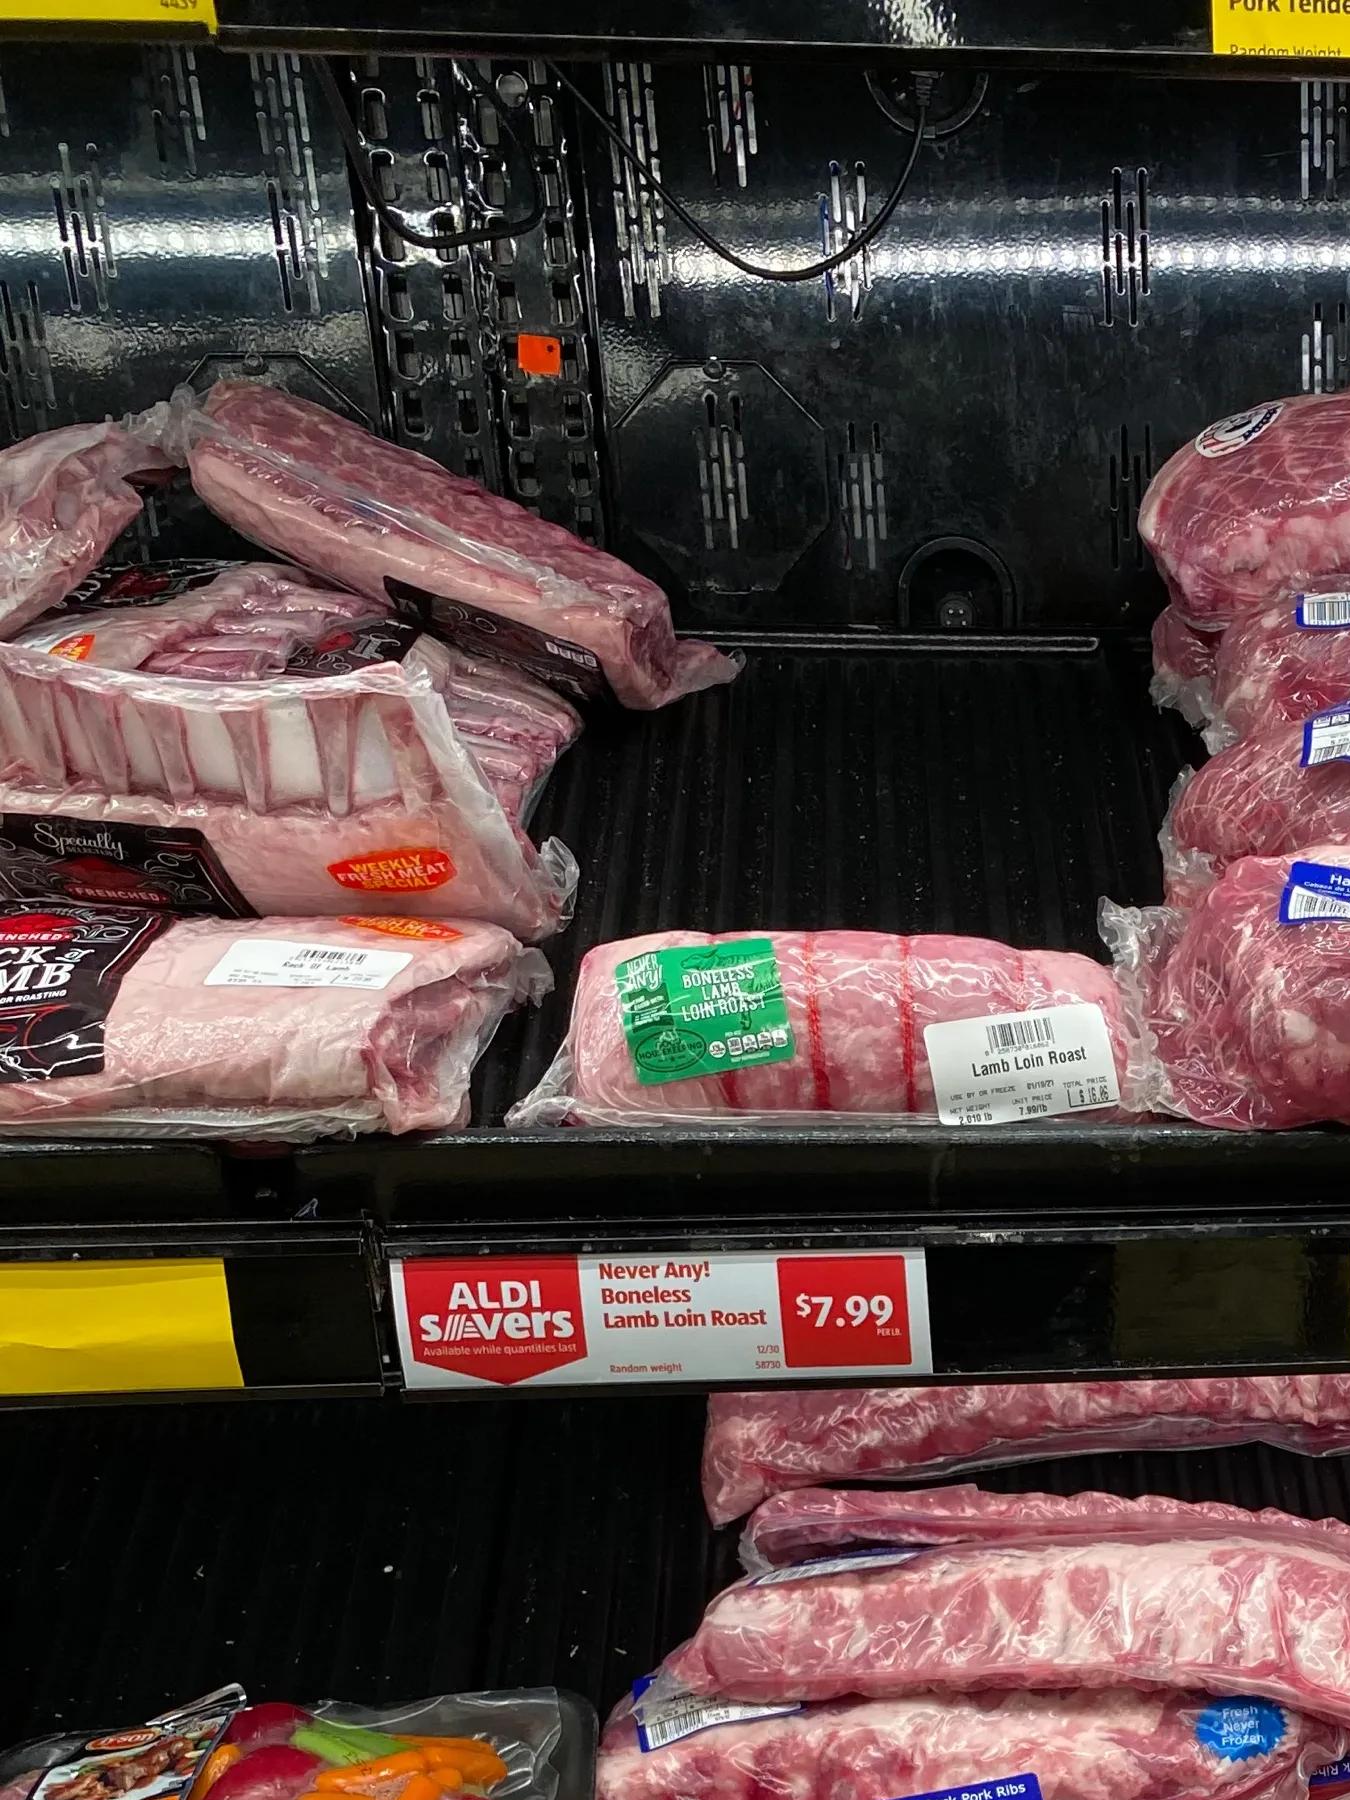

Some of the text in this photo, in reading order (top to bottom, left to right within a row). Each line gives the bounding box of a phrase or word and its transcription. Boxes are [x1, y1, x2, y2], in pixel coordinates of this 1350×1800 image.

[336, 862, 447, 882] FRESH MEAT
[349, 855, 421, 873] WEEKLY
[76, 887, 160, 902] FRENCHED
[682, 964, 755, 988] BONELESS
[701, 982, 742, 1001] LAMB
[682, 1001, 719, 1022] LOIN
[719, 993, 767, 1015] ROAST
[972, 1059, 1010, 1077] Lamb
[1014, 1054, 1044, 1071] Loin
[1048, 1046, 1087, 1065] Roast
[599, 1260, 710, 1281] Never Any!
[448, 1280, 542, 1310] ALDI
[601, 1286, 692, 1305] Boneless
[603, 1307, 767, 1328] Lamb Loin Roast
[795, 1294, 893, 1329] $7.99
[423, 1342, 576, 1357] Available while quantities last
[609, 1363, 682, 1375] Random weight
[1221, 1704, 1258, 1719] Fresh
[1222, 1718, 1260, 1732] Never
[1221, 1732, 1265, 1747] Frozen
[996, 1782, 1026, 1798] Ribs
